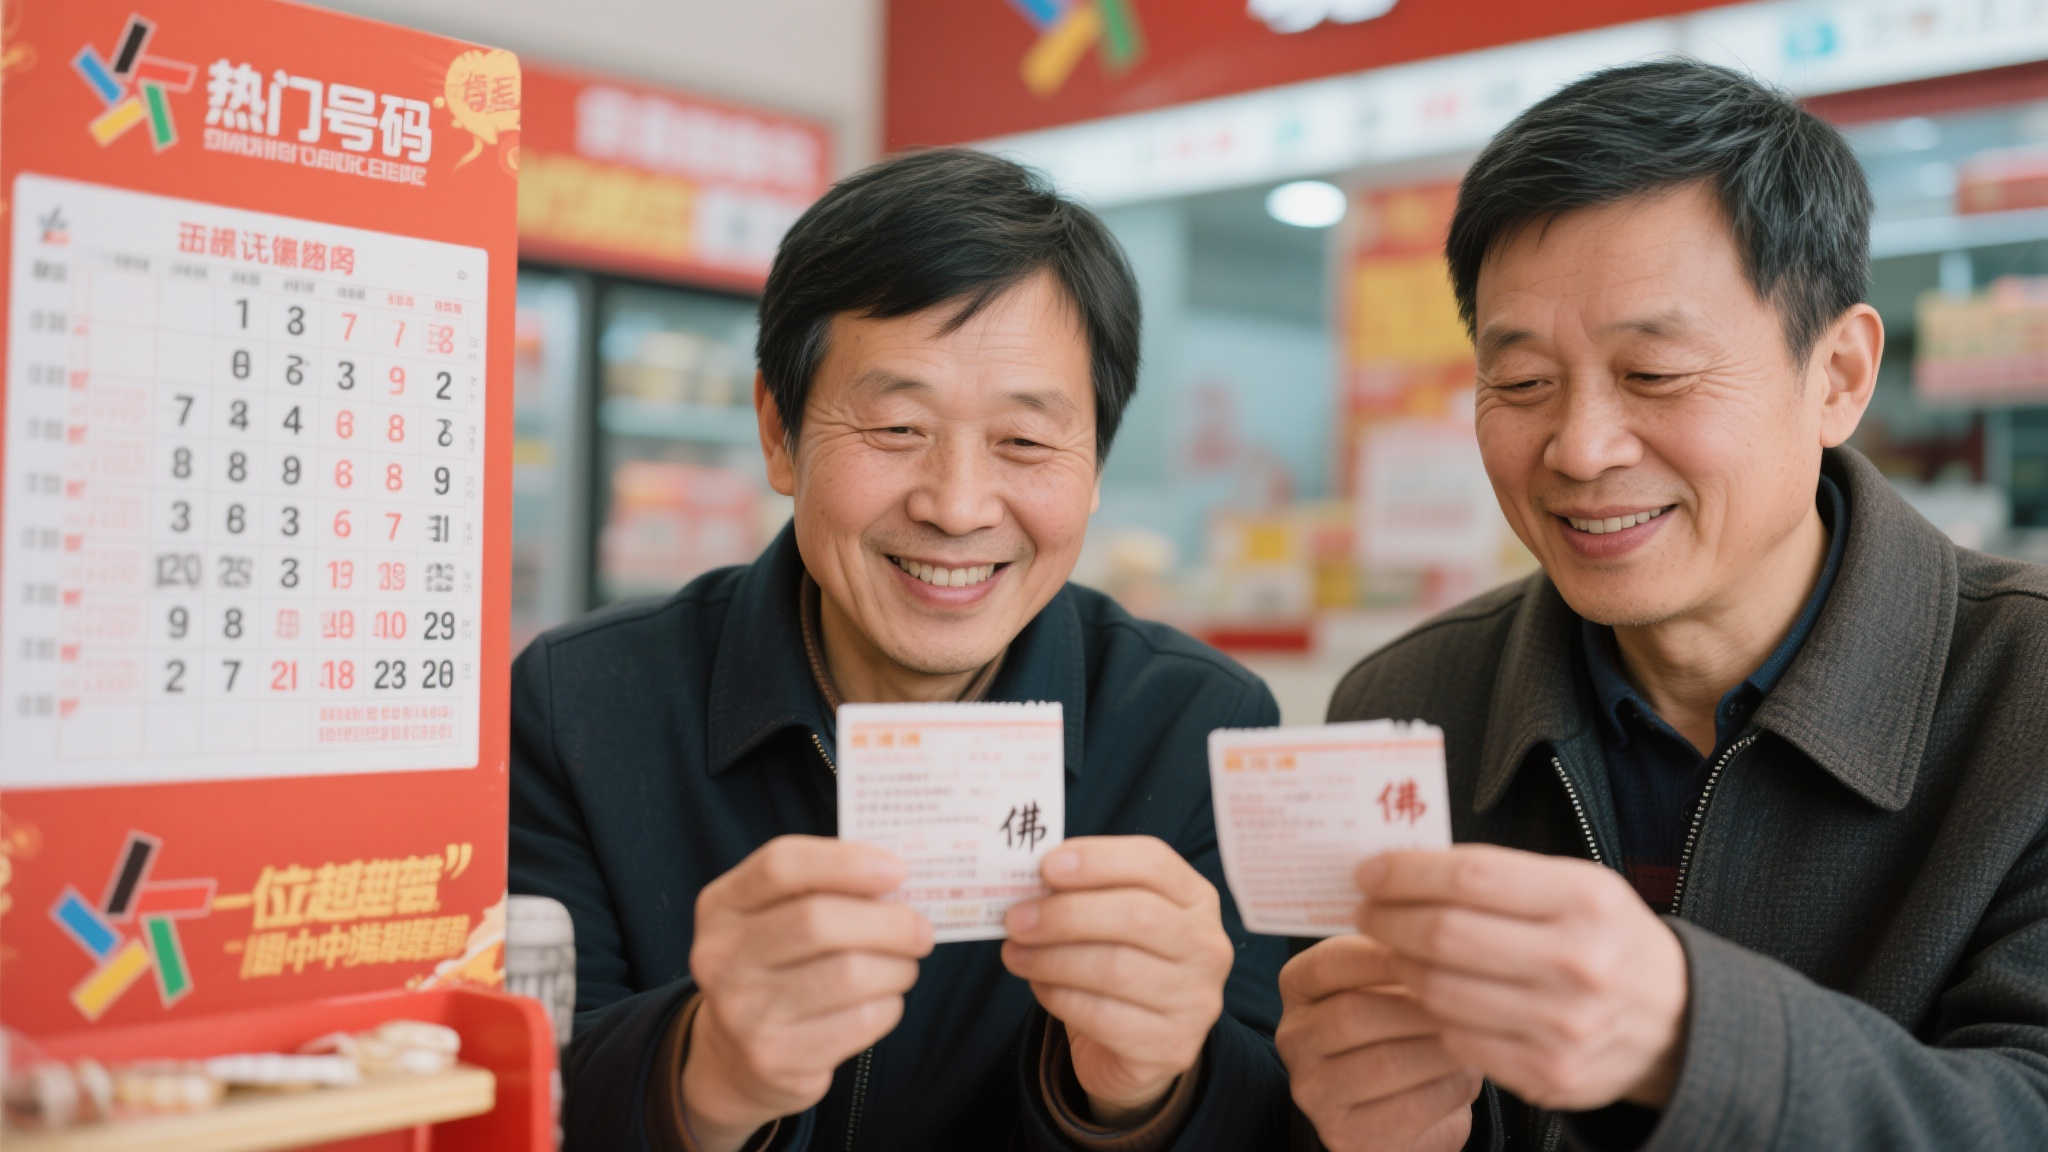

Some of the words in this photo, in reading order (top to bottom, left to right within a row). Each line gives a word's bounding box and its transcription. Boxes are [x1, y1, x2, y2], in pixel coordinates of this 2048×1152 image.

[205, 58, 432, 163] 热门号码
[236, 298, 250, 329] 1
[341, 312, 358, 341] 7
[389, 366, 406, 395] 9
[436, 371, 453, 400] 2
[174, 394, 196, 426] 7
[282, 405, 304, 435] 4
[172, 446, 192, 480] 8
[227, 451, 248, 483] 8
[434, 466, 451, 495] 9
[171, 500, 191, 533] 3
[280, 506, 300, 537] 3
[333, 510, 352, 539] 6
[385, 512, 403, 541] 7
[168, 606, 190, 640] 9
[223, 607, 243, 640] 8
[424, 611, 456, 640] 29
[165, 659, 187, 694] 2
[222, 660, 243, 692] 7
[374, 660, 407, 690] 23
[1376, 777, 1427, 825] 佛
[1000, 799, 1048, 853] 佛
